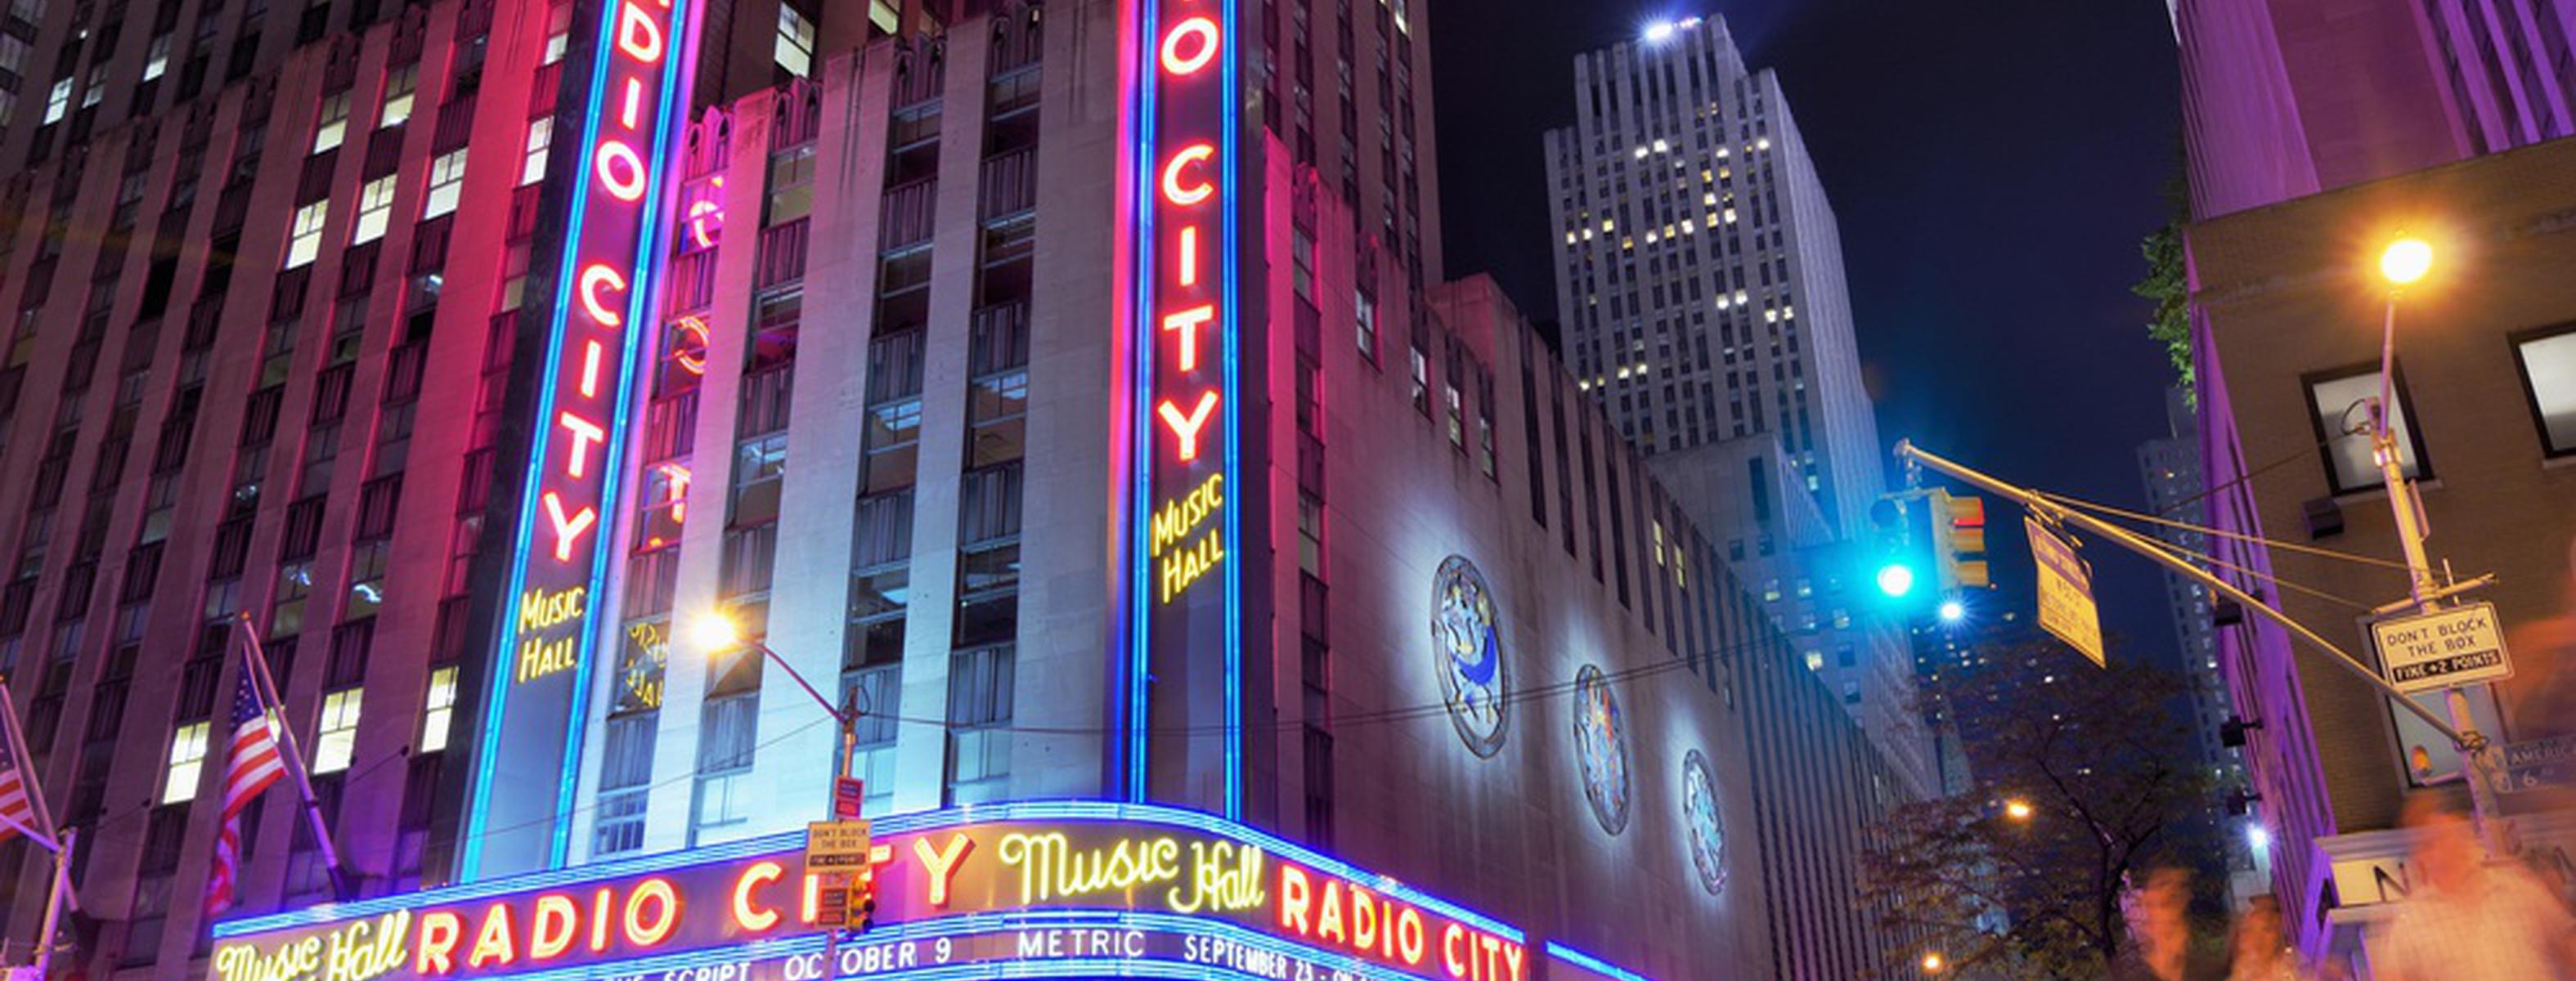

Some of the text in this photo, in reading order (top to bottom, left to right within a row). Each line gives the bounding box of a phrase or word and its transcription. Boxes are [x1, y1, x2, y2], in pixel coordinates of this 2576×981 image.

[543, 0, 671, 562] DIO CITY
[1158, 144, 1218, 461] CITY
[1151, 473, 1223, 558] MUSIC
[1161, 530, 1224, 604] HALL
[518, 587, 586, 635] MUSIC
[2438, 617, 2487, 637] BLOCK
[518, 637, 576, 683] HALL
[2408, 636, 2475, 656] THE BOX
[325, 908, 411, 981] Hall
[416, 878, 677, 975] RADIO
[999, 832, 1179, 905] Music
[1169, 840, 1264, 913] Hall
[1282, 864, 1423, 965] RADIO
[1445, 924, 1522, 981] CITY
[785, 941, 916, 981] OCOBER
[936, 938, 952, 963] 9
[1017, 929, 1144, 957] METRIC
[1184, 934, 1287, 979] SEPTEMBER
